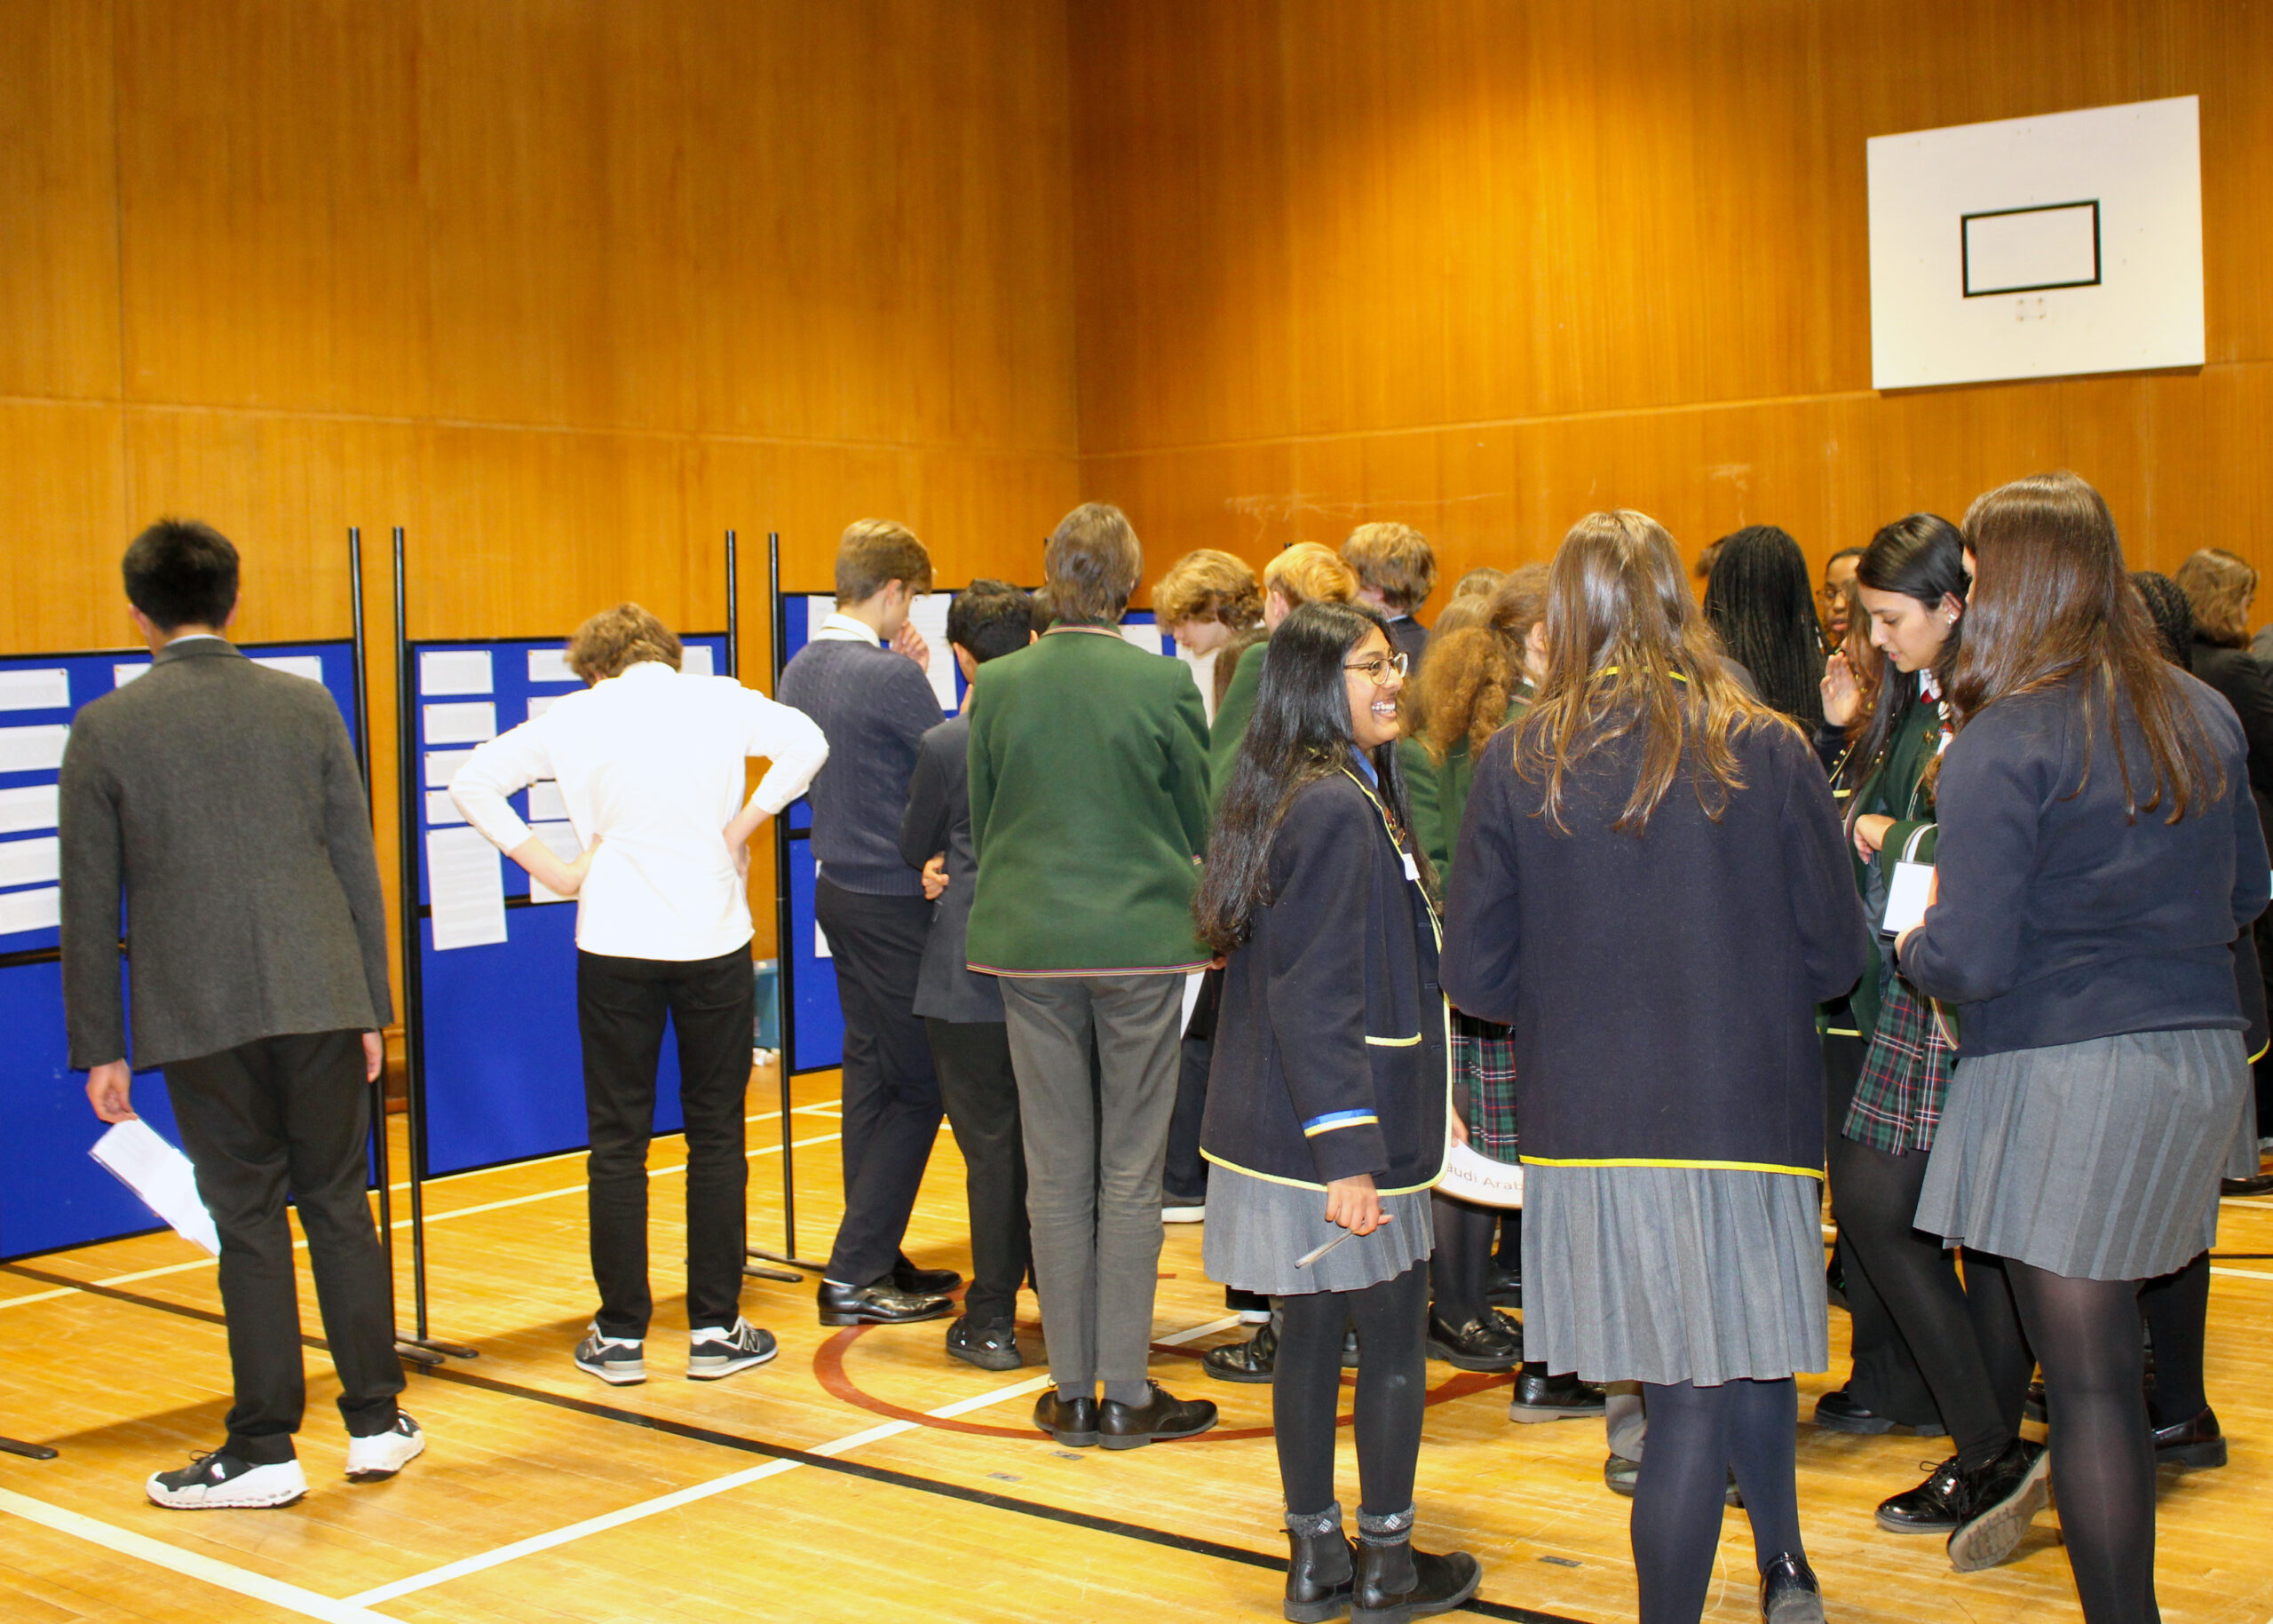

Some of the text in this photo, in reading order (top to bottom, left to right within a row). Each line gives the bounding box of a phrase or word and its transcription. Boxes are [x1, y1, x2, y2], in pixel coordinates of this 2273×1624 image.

[1446, 1163, 1524, 1191] audi Arab
[743, 1328, 761, 1353] N
